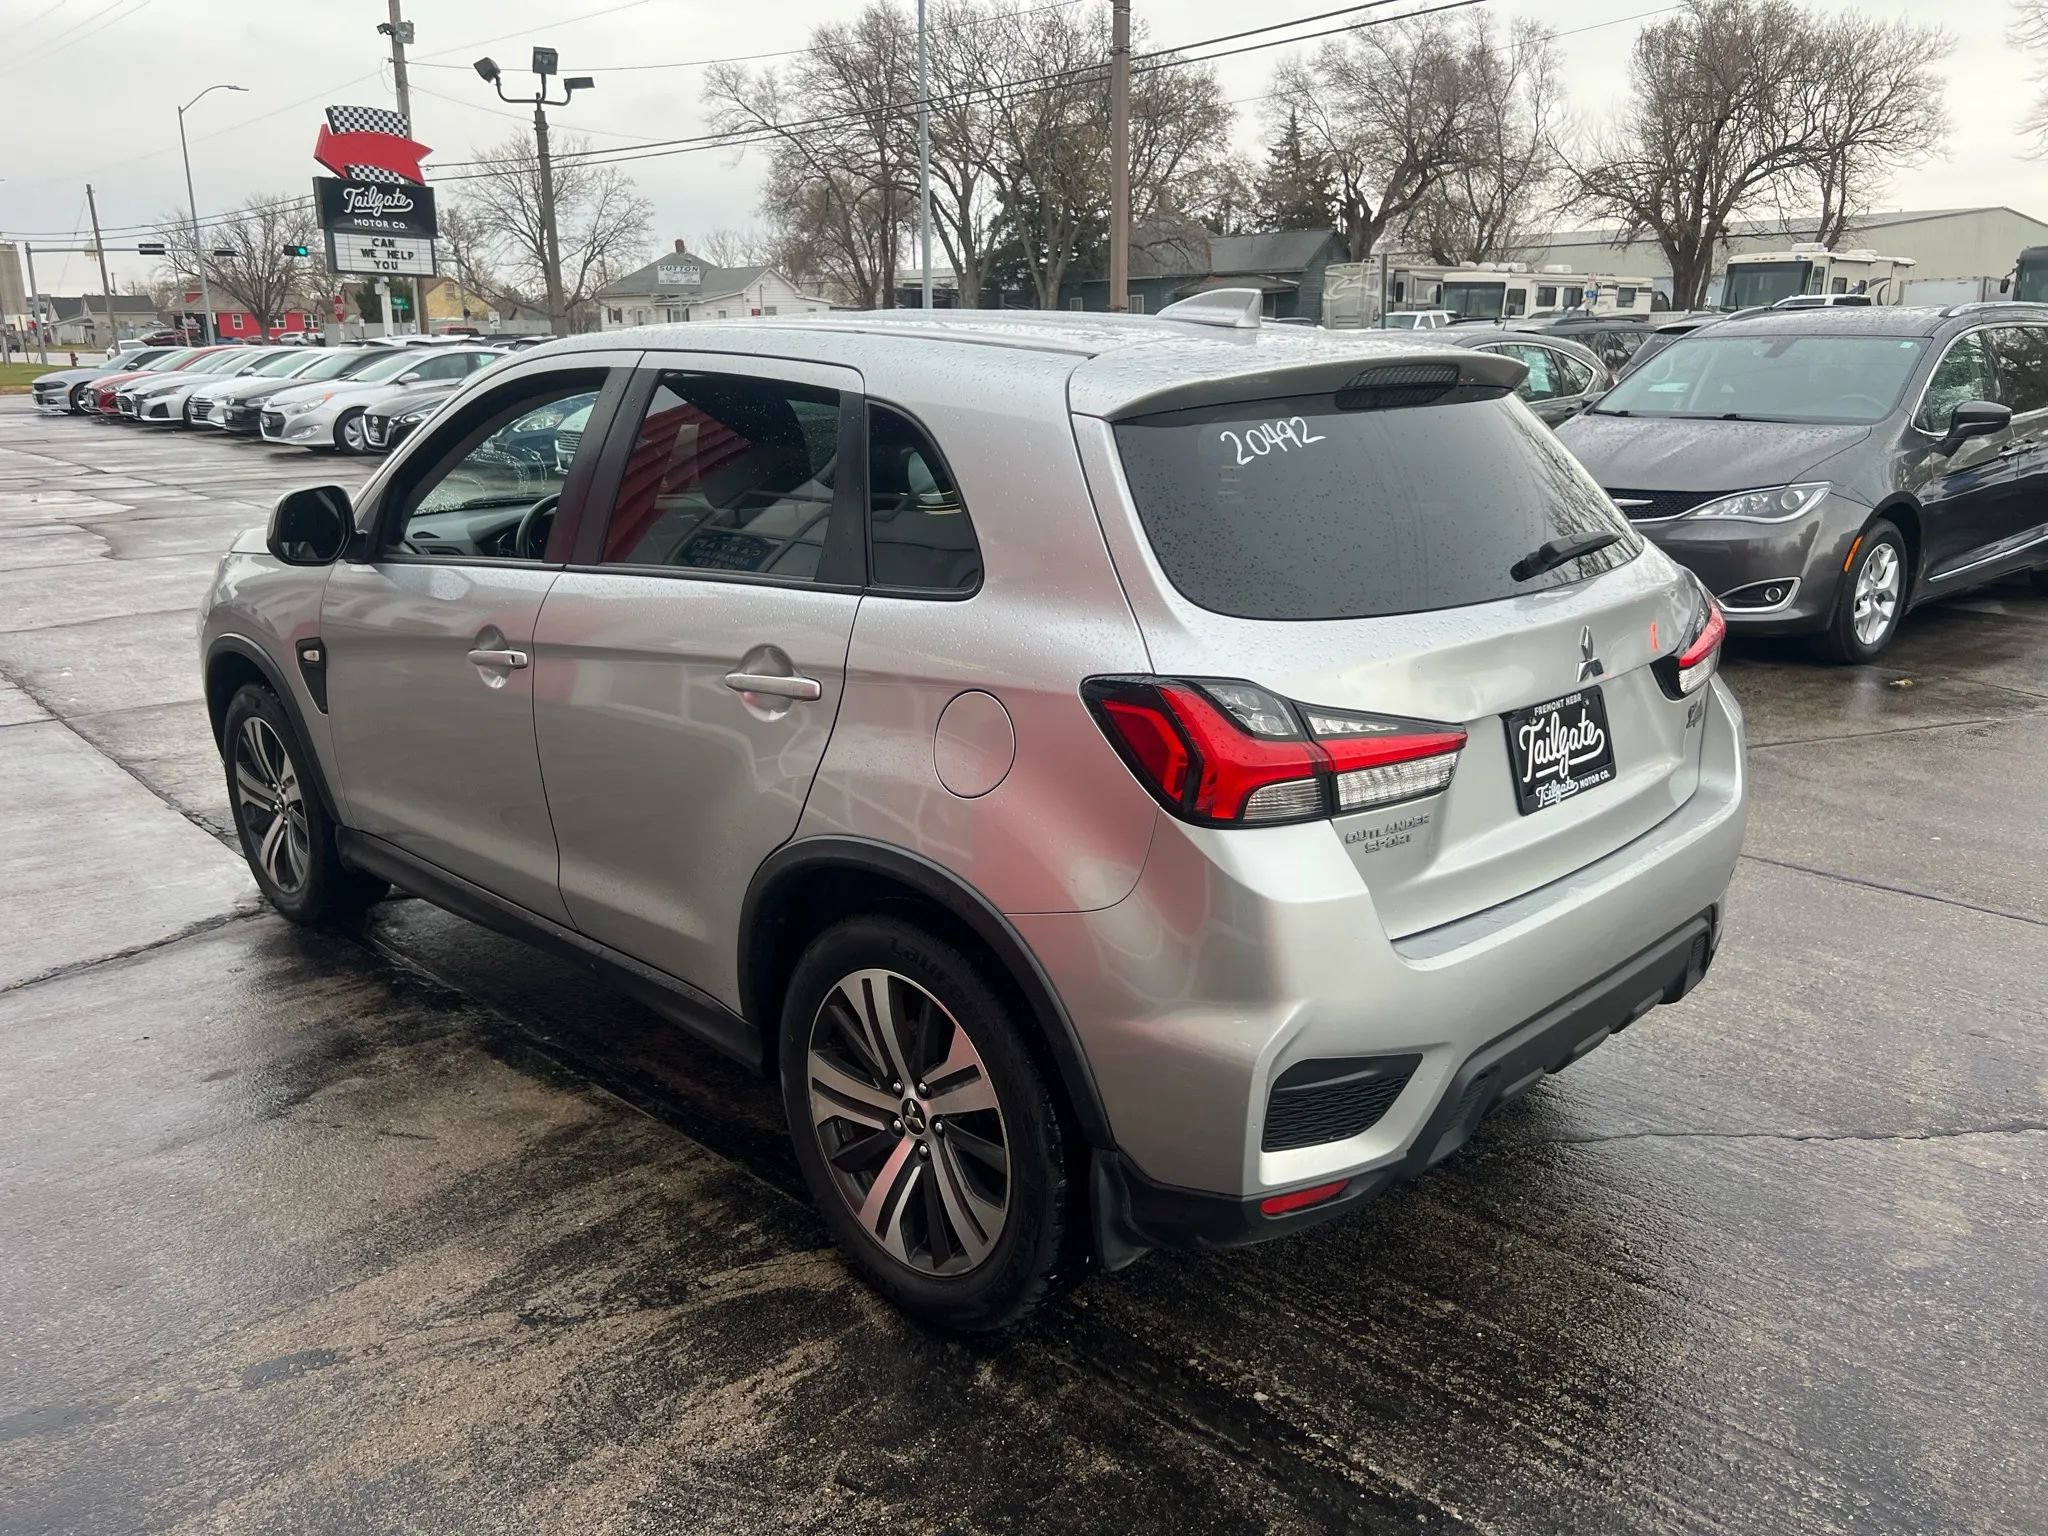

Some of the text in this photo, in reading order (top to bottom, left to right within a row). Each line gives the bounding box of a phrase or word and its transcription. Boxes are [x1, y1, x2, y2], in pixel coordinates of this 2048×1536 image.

[343, 186, 414, 217] Tailgate
[354, 218, 389, 229] MOTOR
[372, 238, 395, 249] CAN
[361, 248, 415, 261] WE HELP
[374, 260, 399, 271] YOU
[659, 265, 698, 273] SUTTON
[1219, 416, 1327, 466] 20492
[1534, 699, 1565, 717] FREMONT
[1519, 708, 1605, 783] Tailgate
[1579, 774, 1600, 789] MOTOR
[1345, 813, 1429, 844] OUTLANDER
